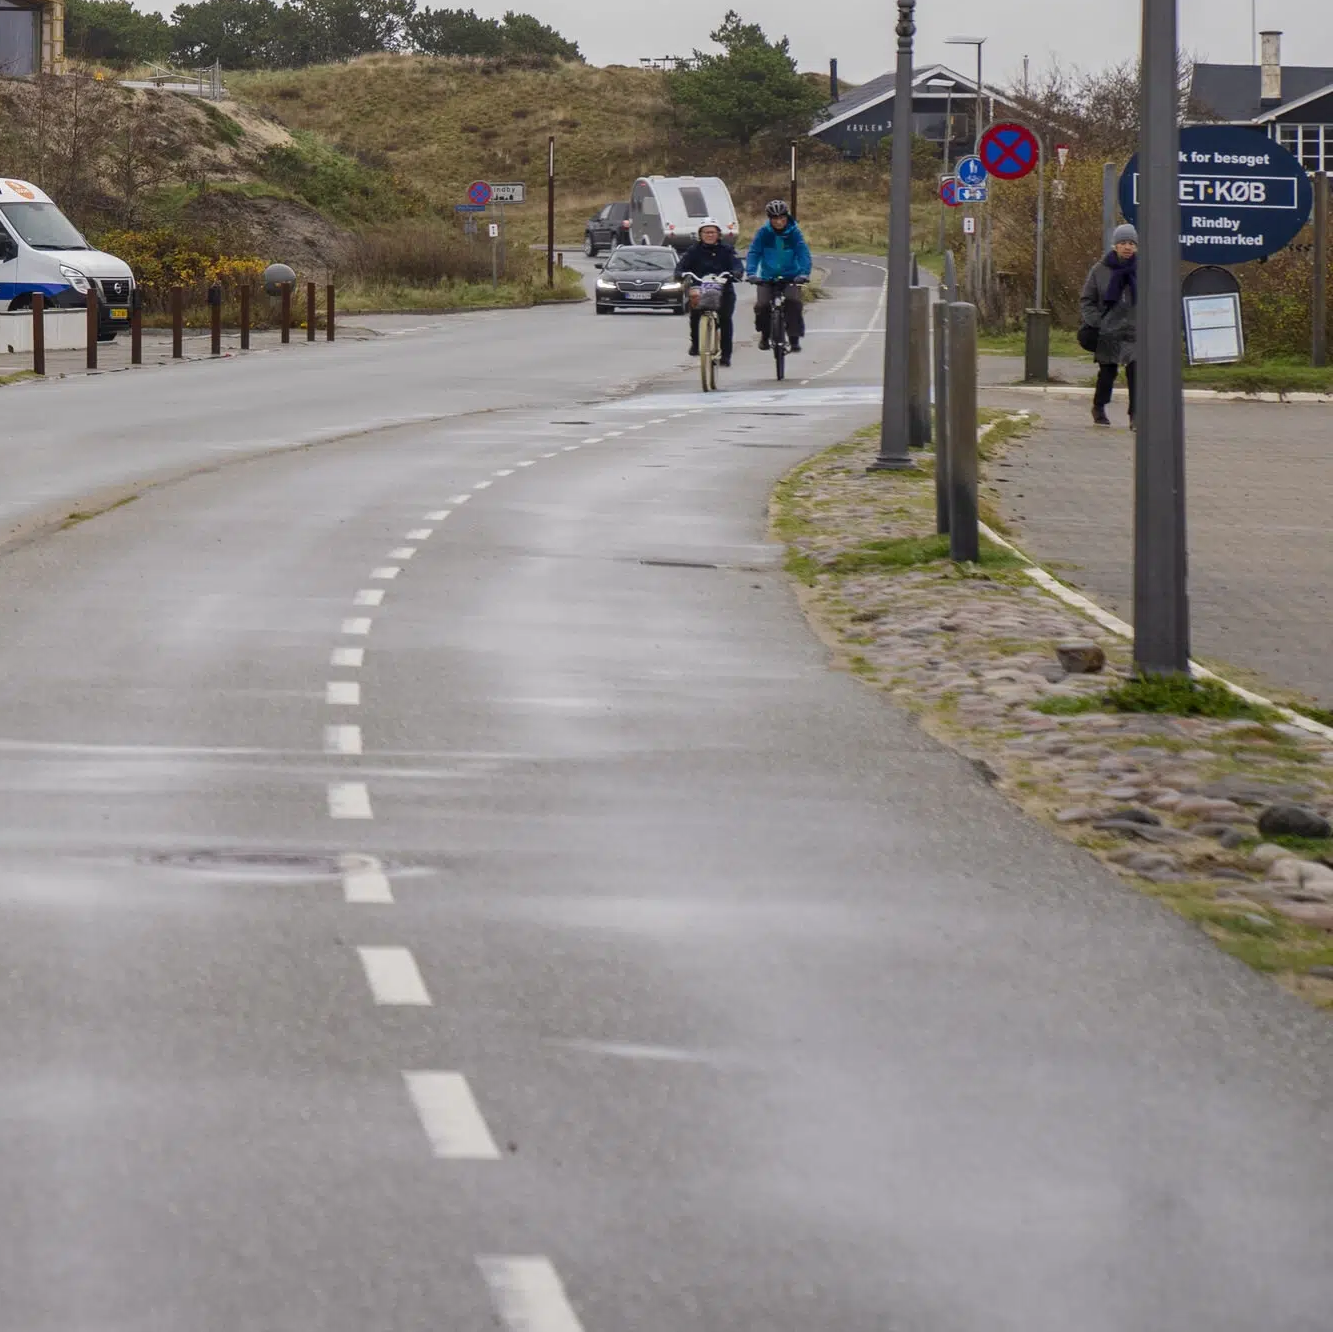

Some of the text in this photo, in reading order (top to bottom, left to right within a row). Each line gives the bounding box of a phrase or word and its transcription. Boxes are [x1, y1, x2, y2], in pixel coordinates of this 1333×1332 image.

[1191, 151, 1211, 163] for
[1214, 152, 1270, 167] besøget
[1192, 216, 1240, 231] Rindby
[1178, 234, 1264, 246] upermarked
